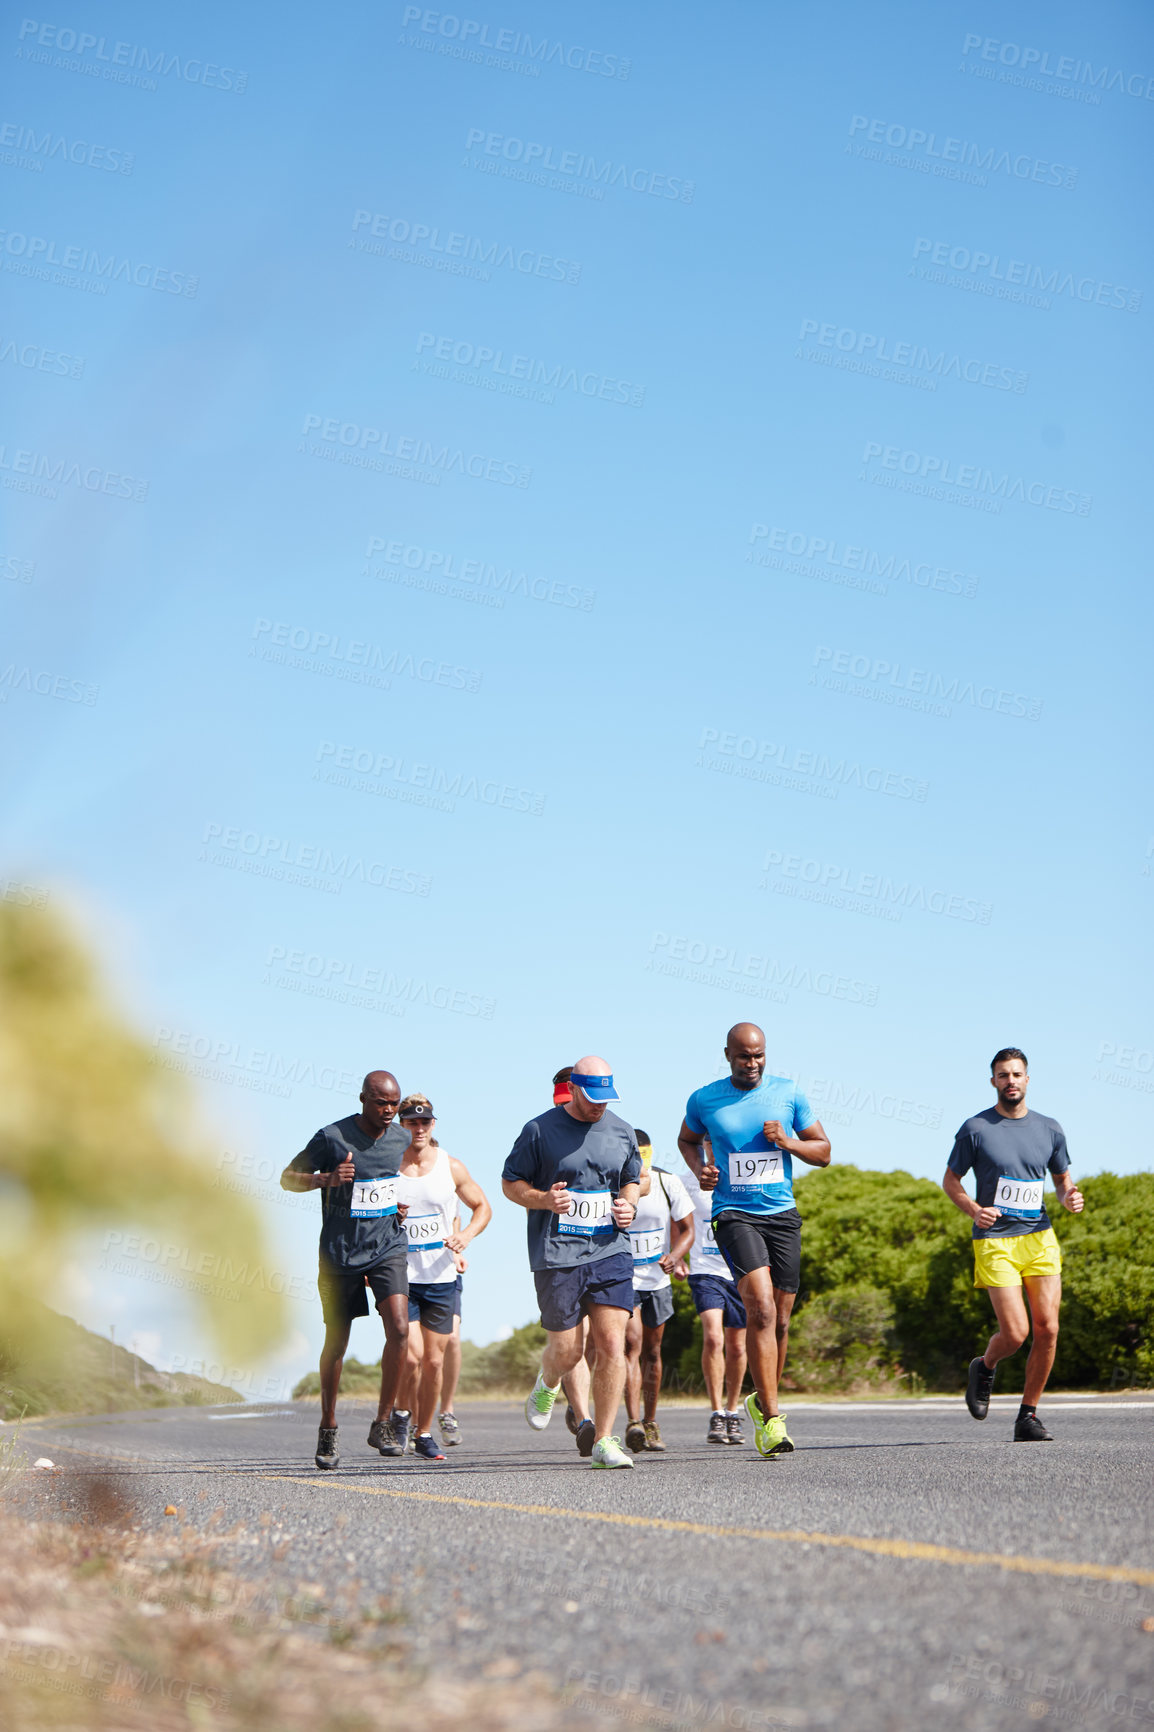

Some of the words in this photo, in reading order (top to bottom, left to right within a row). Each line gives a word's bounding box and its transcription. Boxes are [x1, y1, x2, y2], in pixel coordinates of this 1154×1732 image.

[735, 1158, 779, 1178] 1977
[1001, 1184, 1040, 1204] 0108
[559, 1224, 576, 1233] 2015
